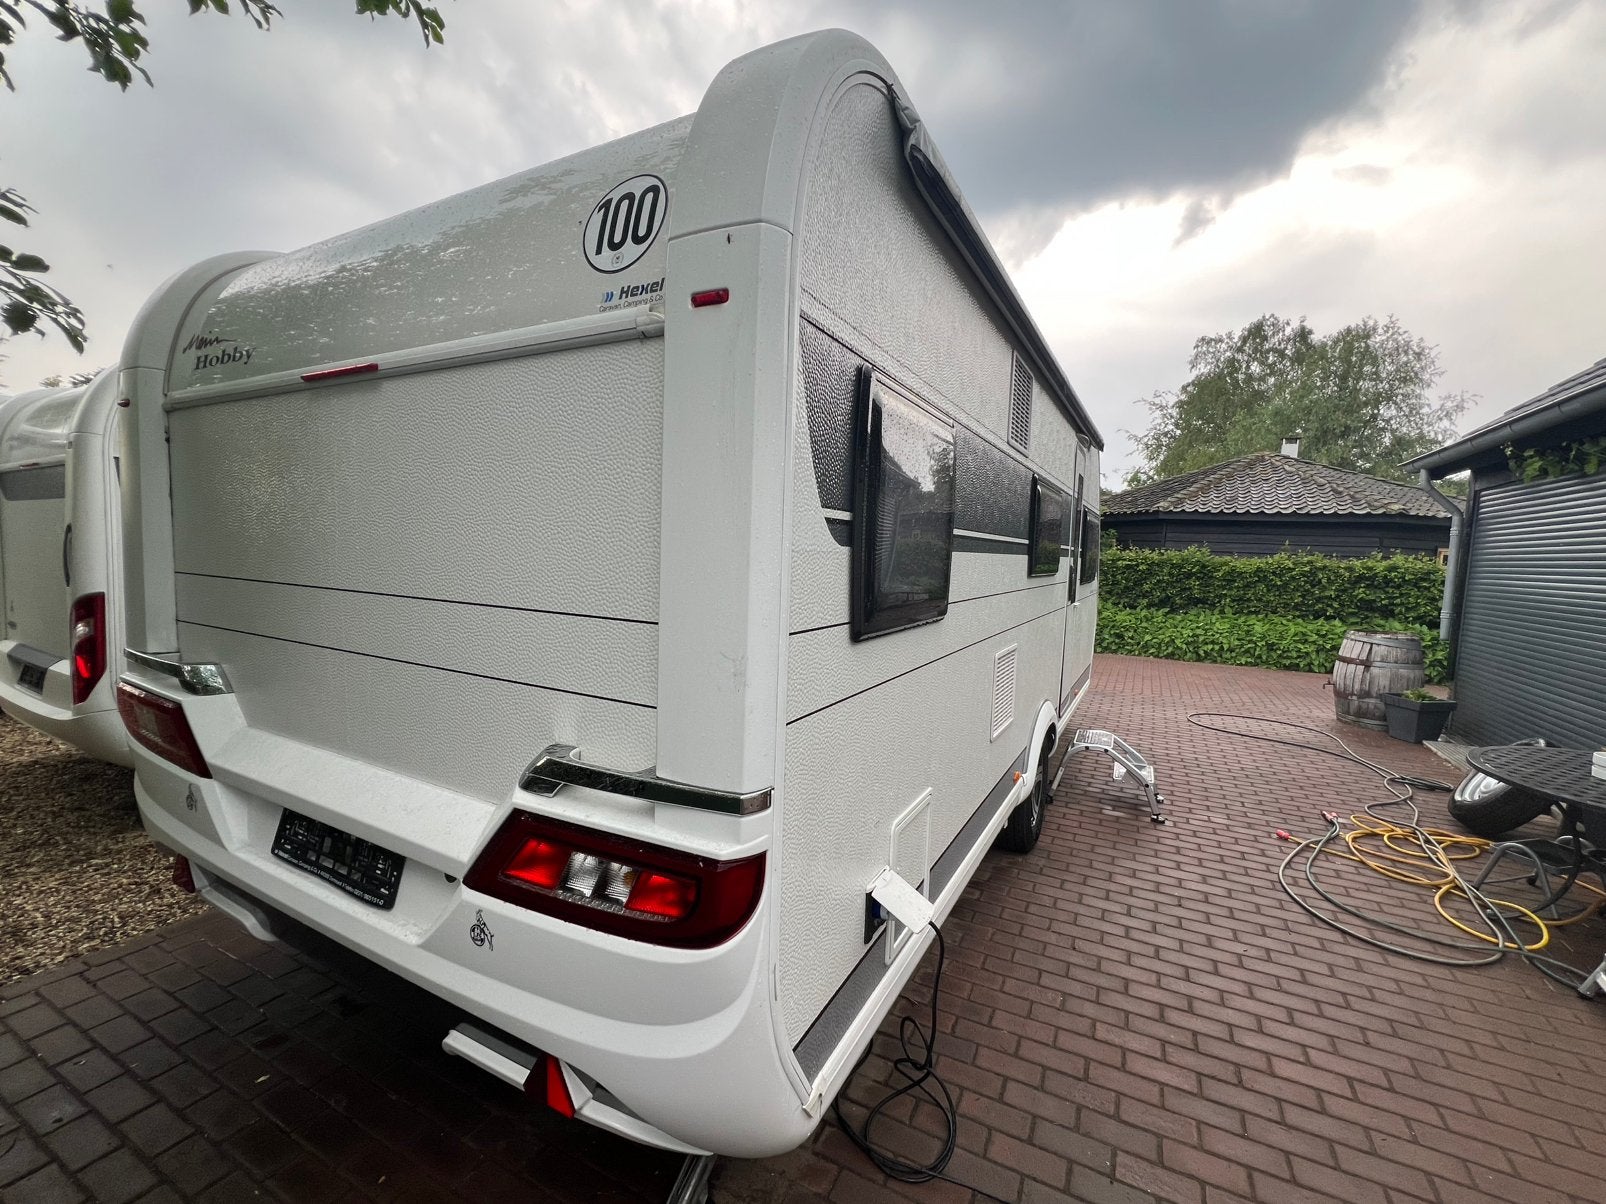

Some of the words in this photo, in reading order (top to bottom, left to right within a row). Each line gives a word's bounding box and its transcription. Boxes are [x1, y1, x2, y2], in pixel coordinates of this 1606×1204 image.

[595, 184, 661, 256] 100
[619, 277, 665, 300] Hexel
[194, 346, 257, 370] Hobby
